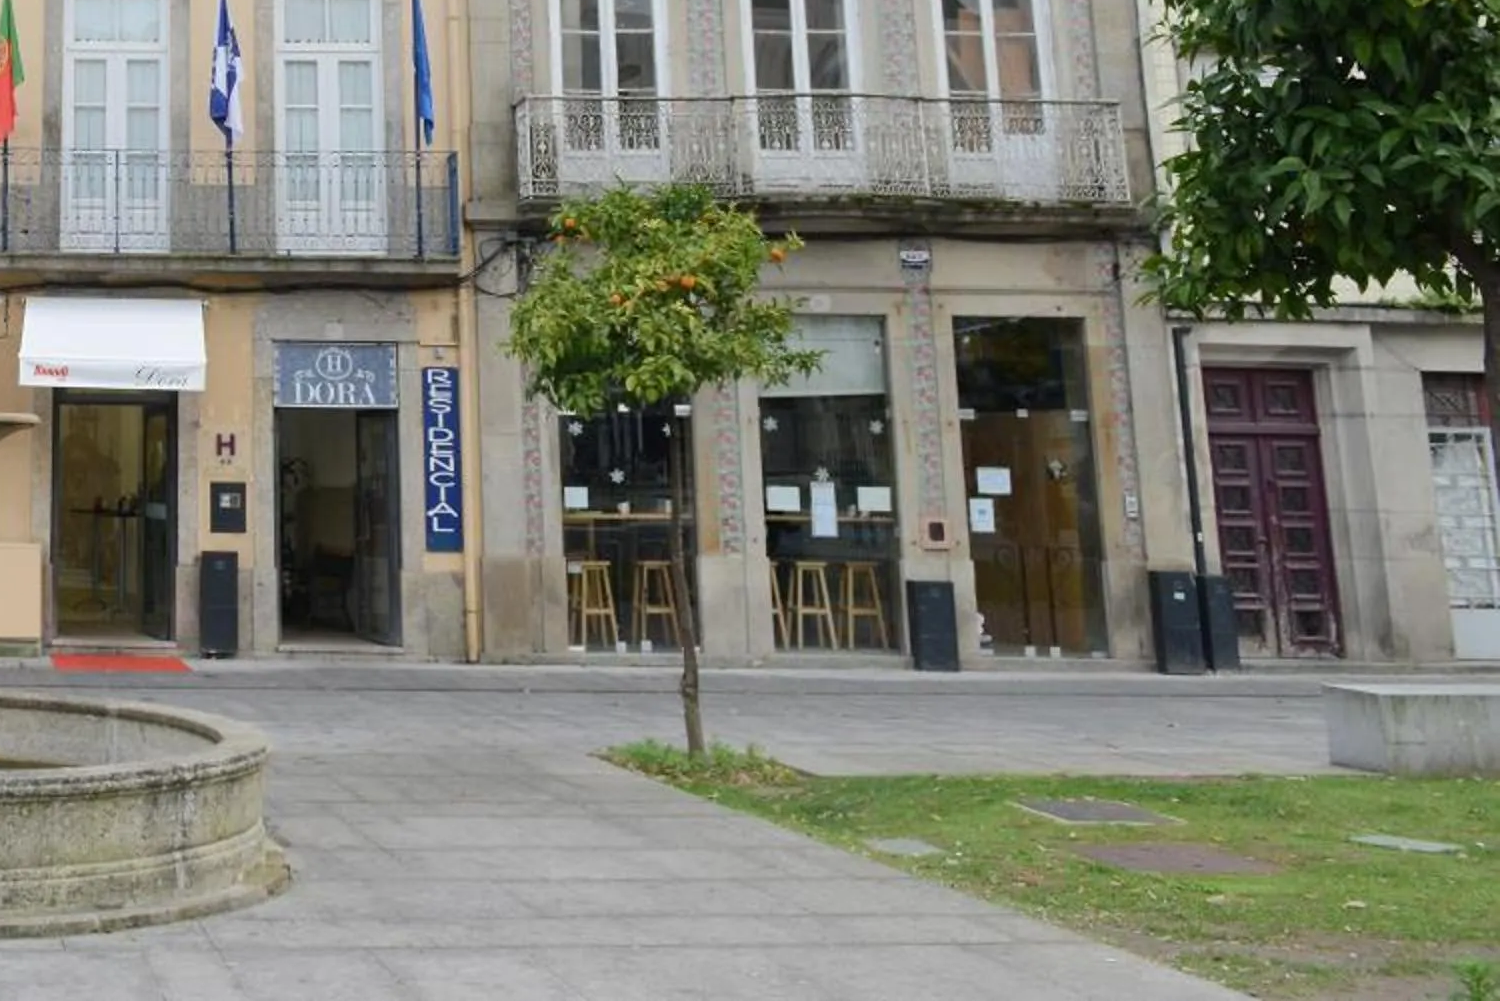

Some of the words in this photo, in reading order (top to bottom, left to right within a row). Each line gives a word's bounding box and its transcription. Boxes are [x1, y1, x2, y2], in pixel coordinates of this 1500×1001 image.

[326, 355, 343, 373] H
[294, 381, 377, 405] DORA
[215, 433, 236, 456] H
[427, 368, 459, 533] RESIDENCIAL
